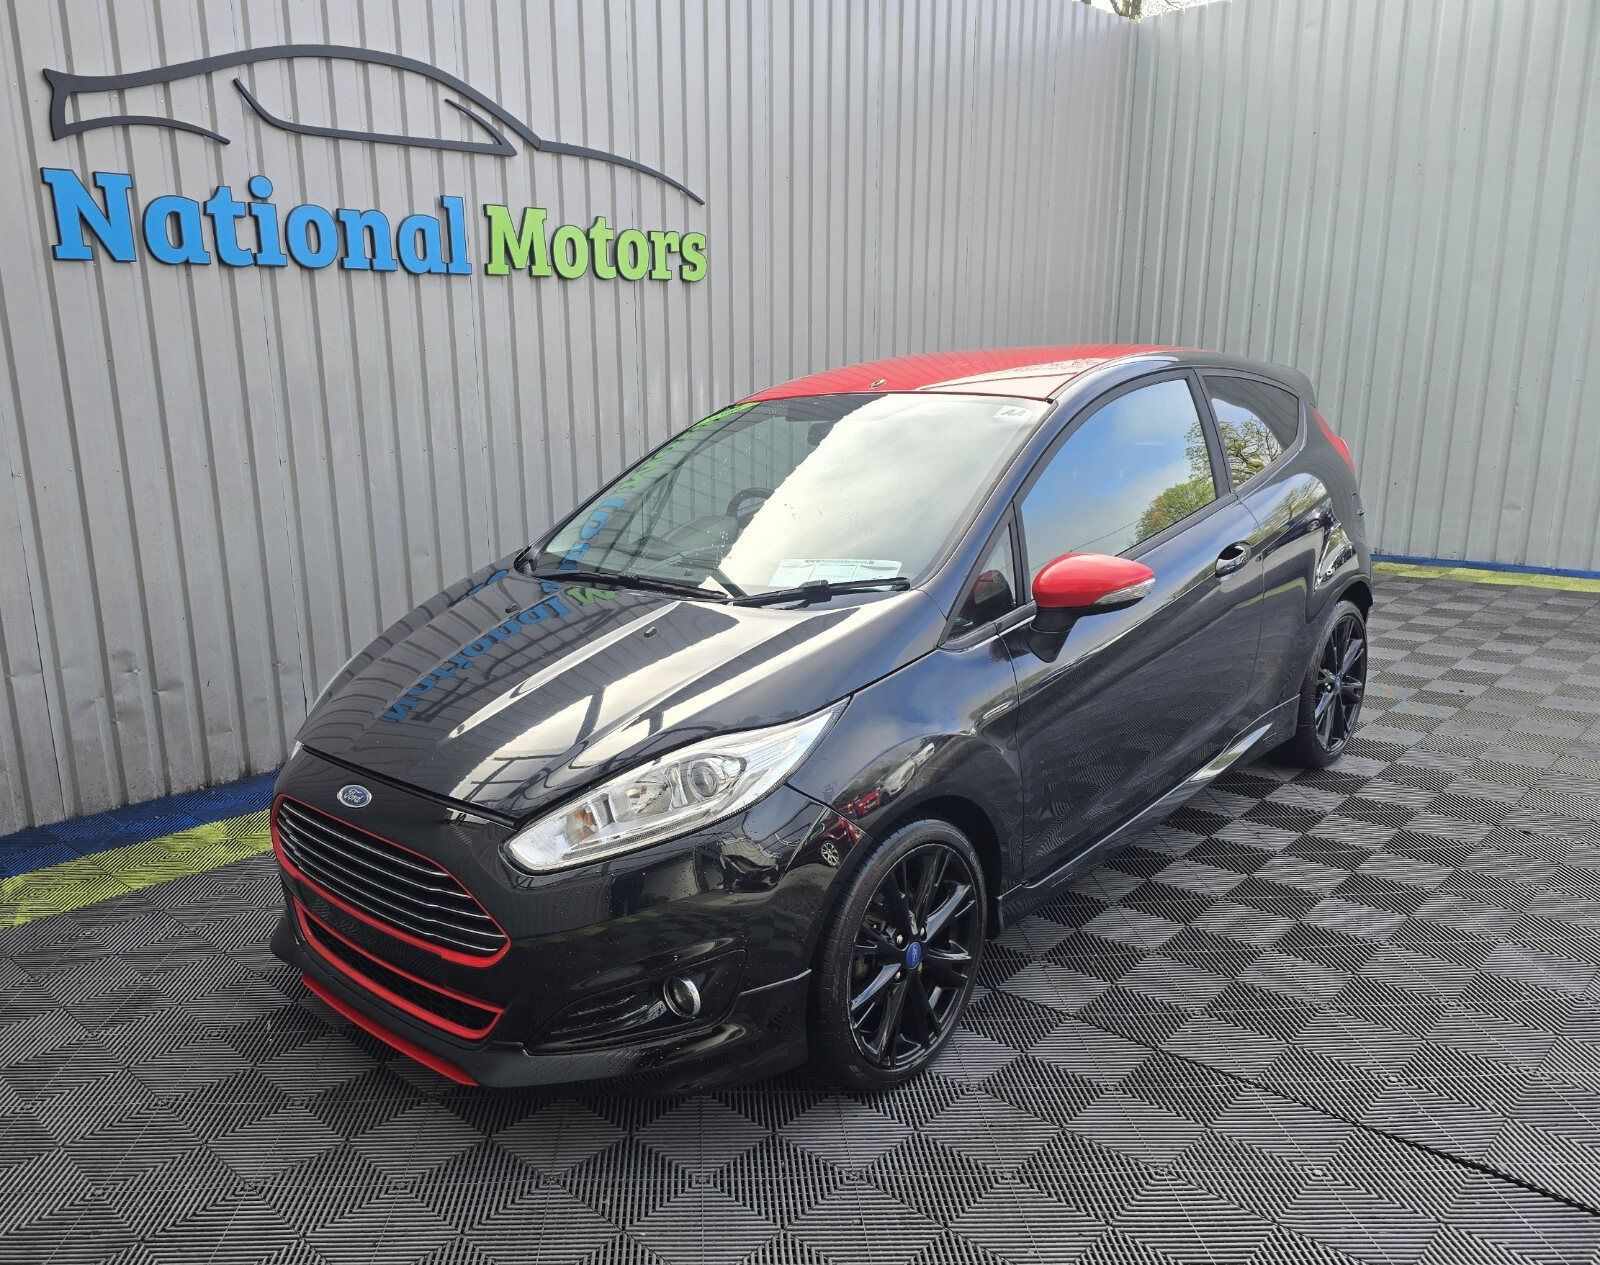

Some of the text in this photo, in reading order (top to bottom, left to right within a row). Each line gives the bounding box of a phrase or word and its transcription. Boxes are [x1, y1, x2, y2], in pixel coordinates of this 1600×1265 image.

[41, 167, 707, 283] National Motors
[343, 788, 365, 804] Ford
